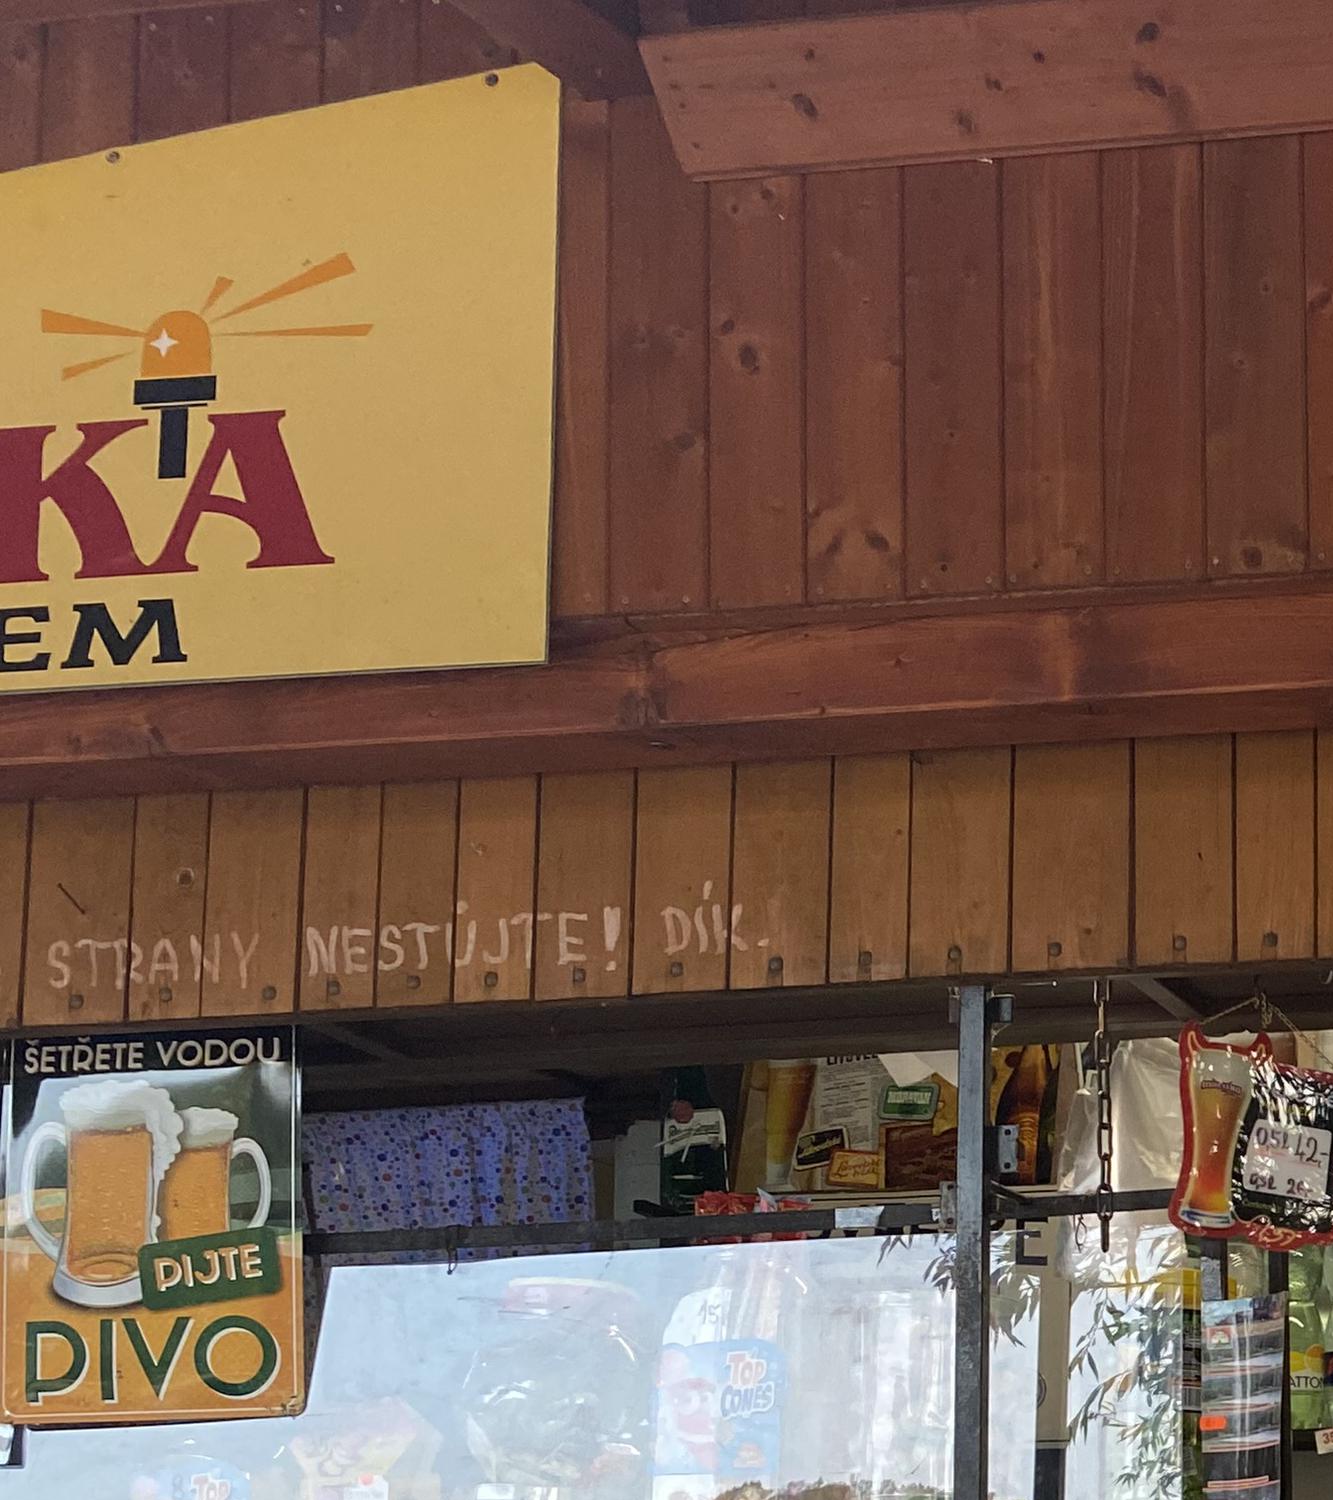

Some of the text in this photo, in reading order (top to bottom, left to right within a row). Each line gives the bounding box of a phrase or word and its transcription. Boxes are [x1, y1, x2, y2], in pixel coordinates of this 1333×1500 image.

[47, 931, 260, 990] STRANY
[23, 1036, 282, 1076] ŠETŘETE VODOU
[153, 1243, 264, 1292] PIJTE
[24, 1313, 281, 1406] PIVO
[725, 1348, 767, 1388] TOP
[720, 1378, 773, 1419] CONES
